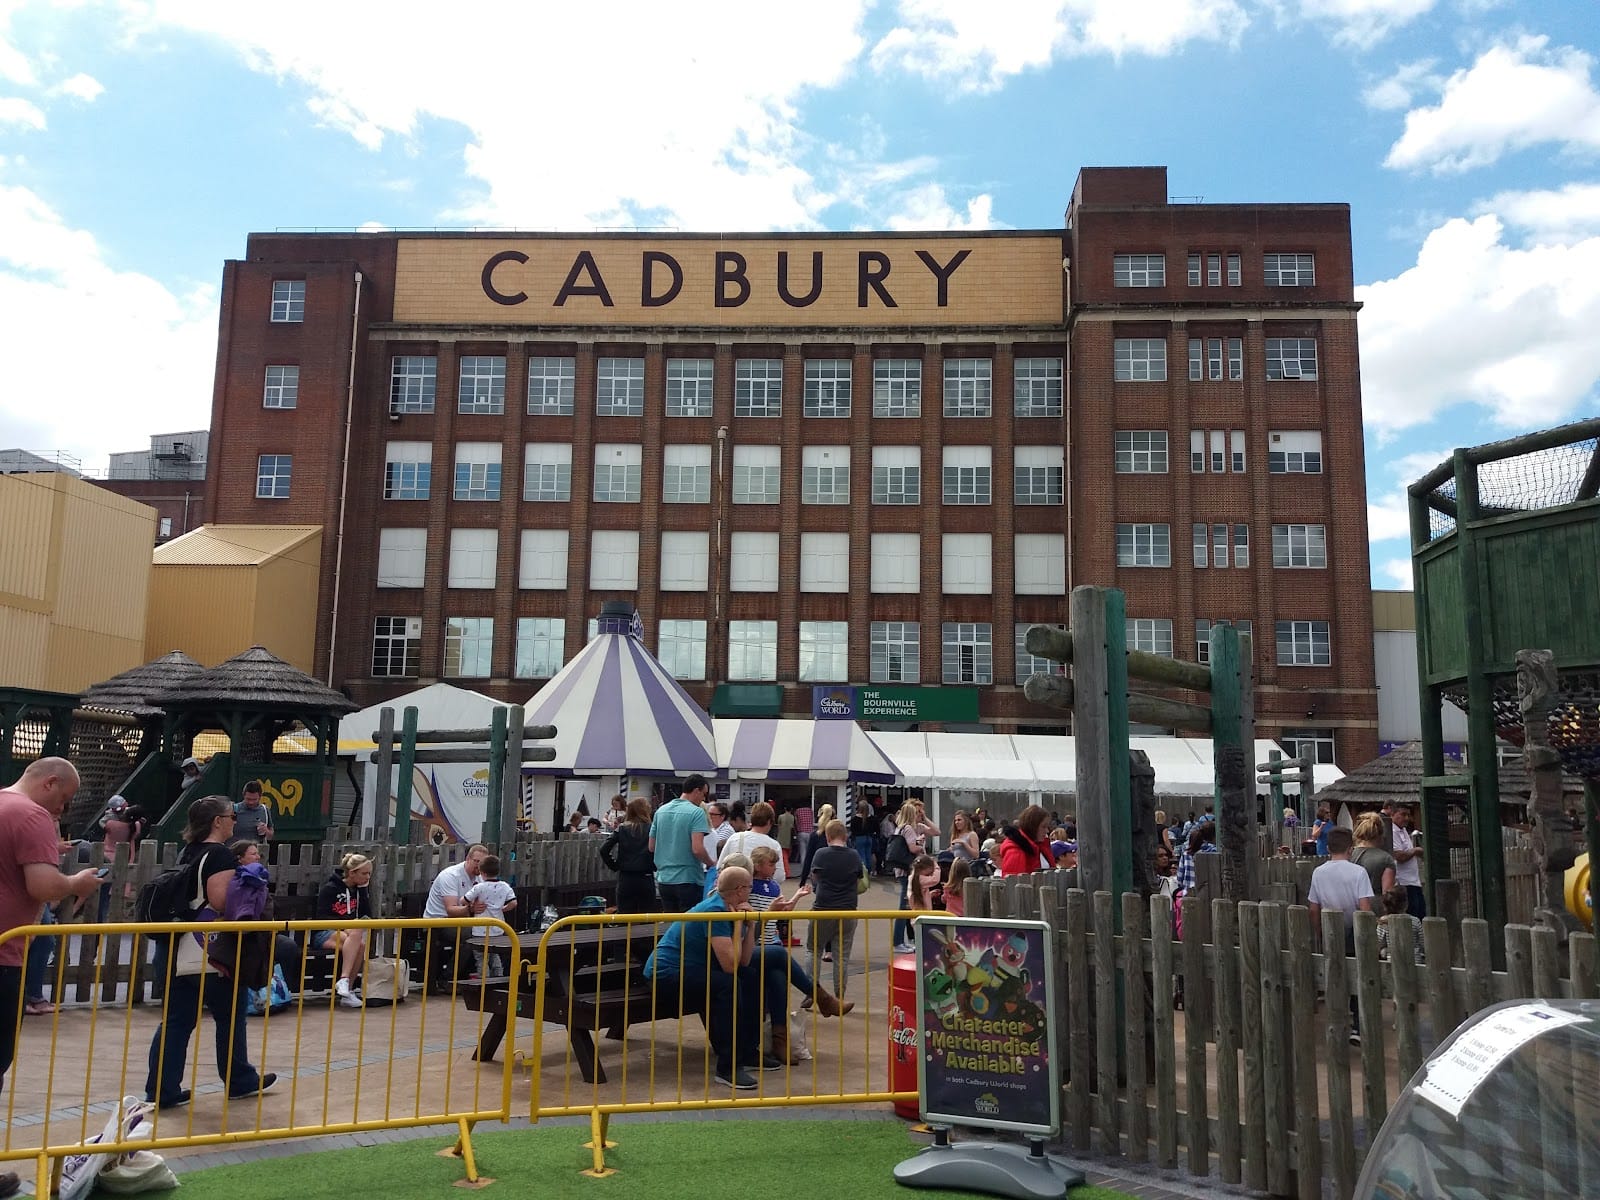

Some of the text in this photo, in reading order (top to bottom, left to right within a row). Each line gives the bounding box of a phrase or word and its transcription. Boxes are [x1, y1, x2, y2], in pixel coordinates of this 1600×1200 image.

[480, 250, 972, 308] CADBURY
[821, 698, 845, 707] Cadbury
[821, 706, 850, 714] WORLD
[942, 1012, 1025, 1036] Character
[931, 1030, 1040, 1056] Merchandise
[946, 1051, 1026, 1075] Available
[952, 1076, 965, 1084] both
[966, 1078, 988, 1087] Cadbury
[990, 1080, 1009, 1088] World
